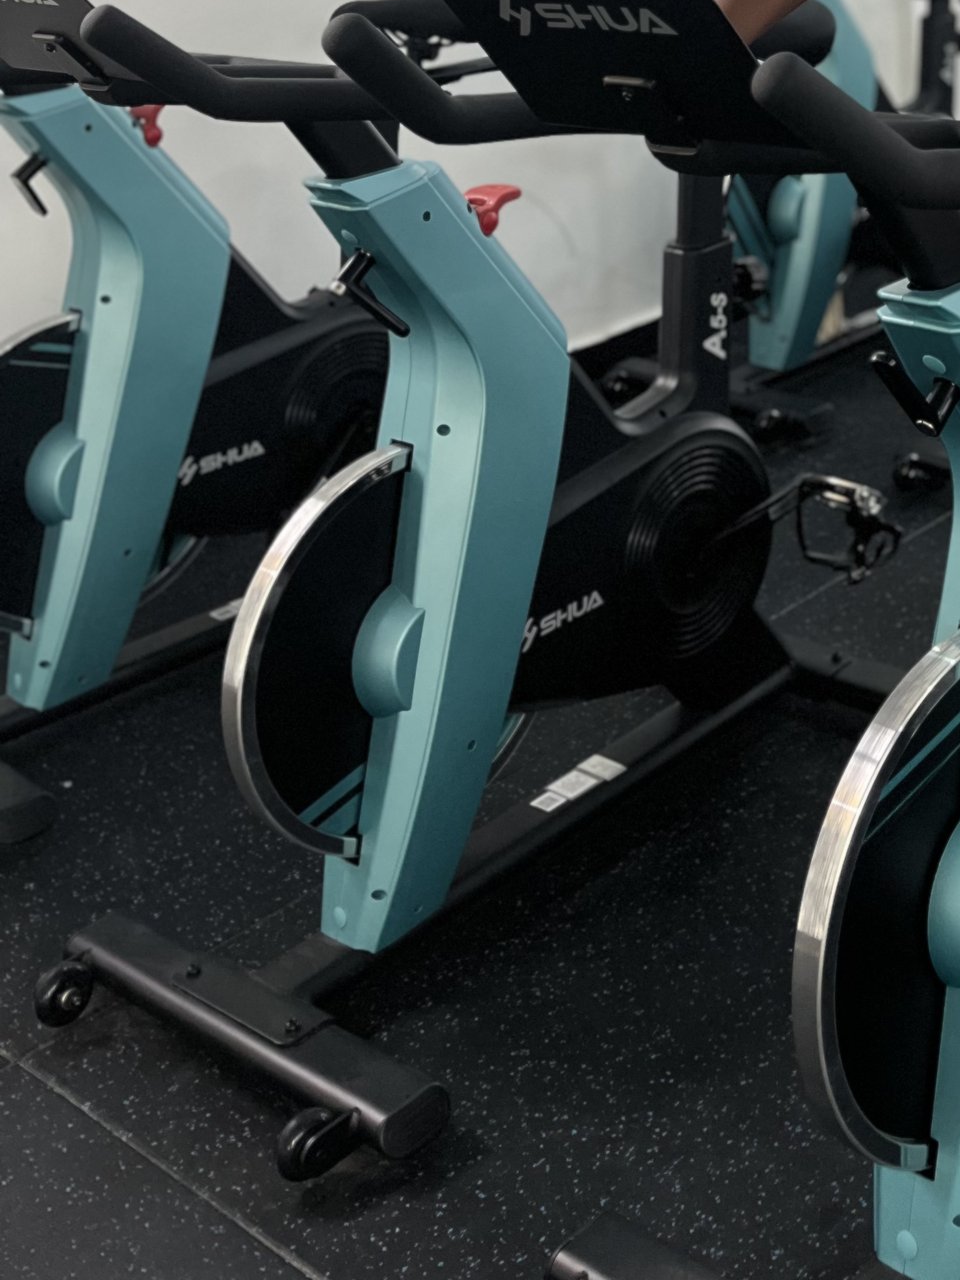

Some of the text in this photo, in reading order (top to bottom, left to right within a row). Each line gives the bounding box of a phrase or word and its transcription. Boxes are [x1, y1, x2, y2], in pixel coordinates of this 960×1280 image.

[534, 3, 679, 36] SHUA
[200, 439, 266, 475] SHUA
[540, 590, 604, 637] SHUA
